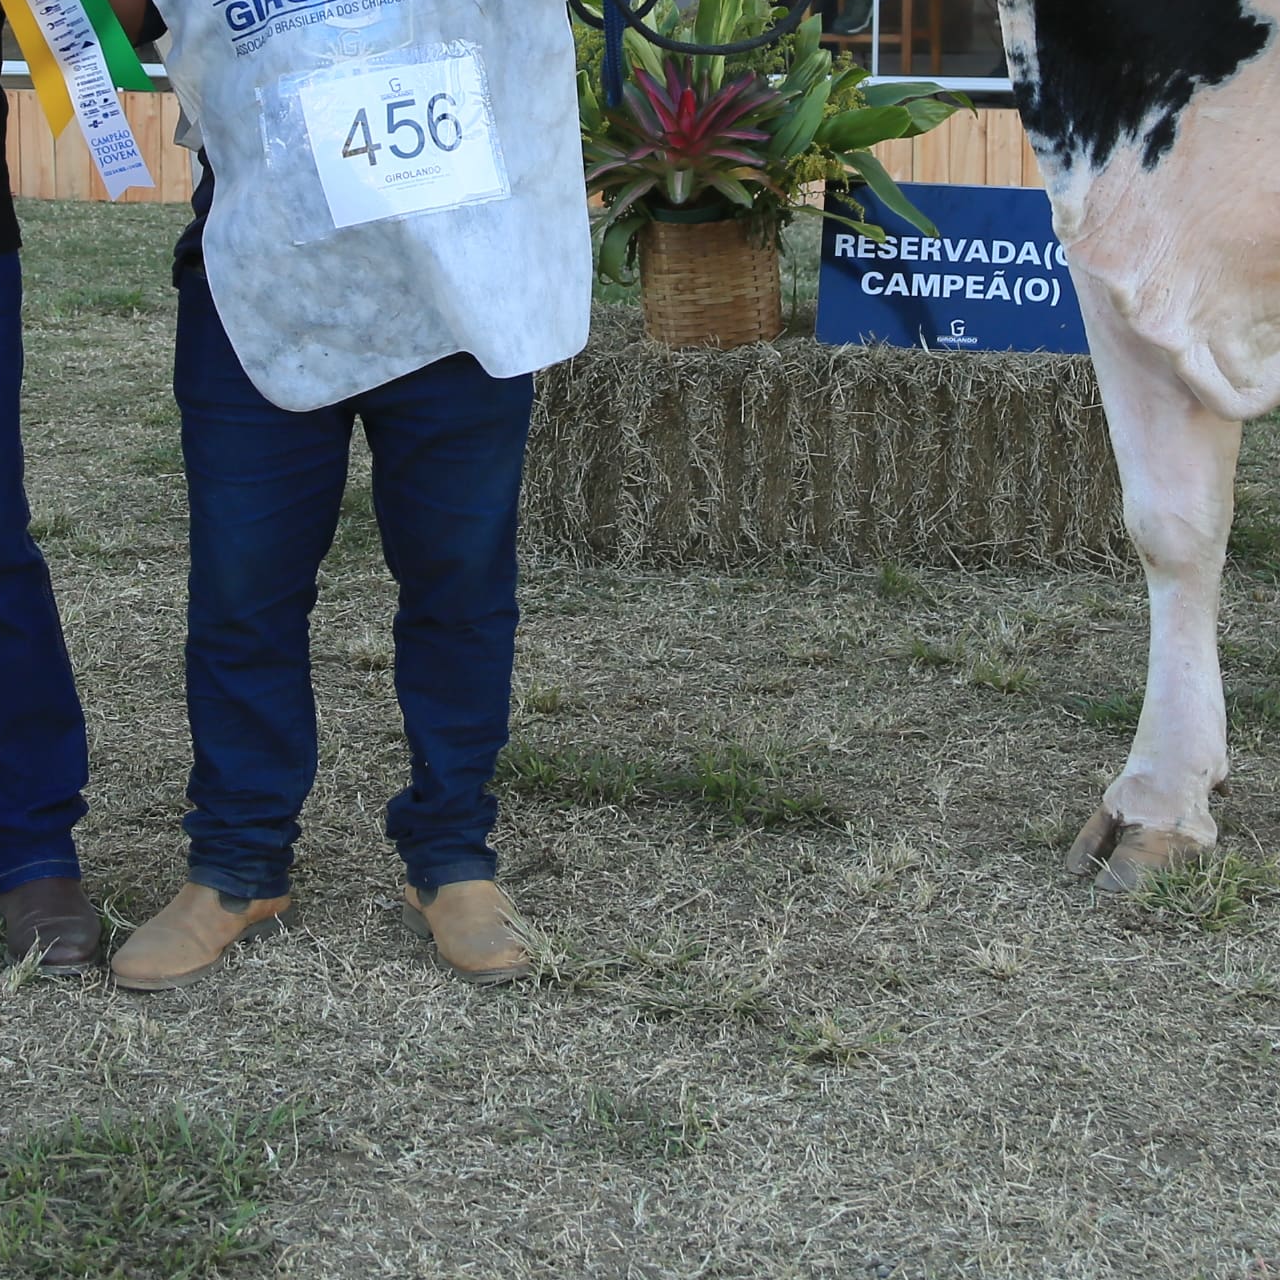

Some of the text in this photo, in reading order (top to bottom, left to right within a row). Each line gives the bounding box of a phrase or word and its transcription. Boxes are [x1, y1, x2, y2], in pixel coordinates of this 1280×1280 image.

[274, 6, 335, 36] BRASILEIRA
[336, 1, 360, 18] DOS
[90, 130, 131, 148] CAMPEÃO
[342, 93, 463, 167] 456
[94, 140, 135, 156] TOURO
[99, 149, 138, 168] JOVEM
[384, 165, 442, 184] GIROLANDO
[860, 270, 1062, 307] CAMPEÃ(O)
[936, 336, 979, 345] GIROLANDO
